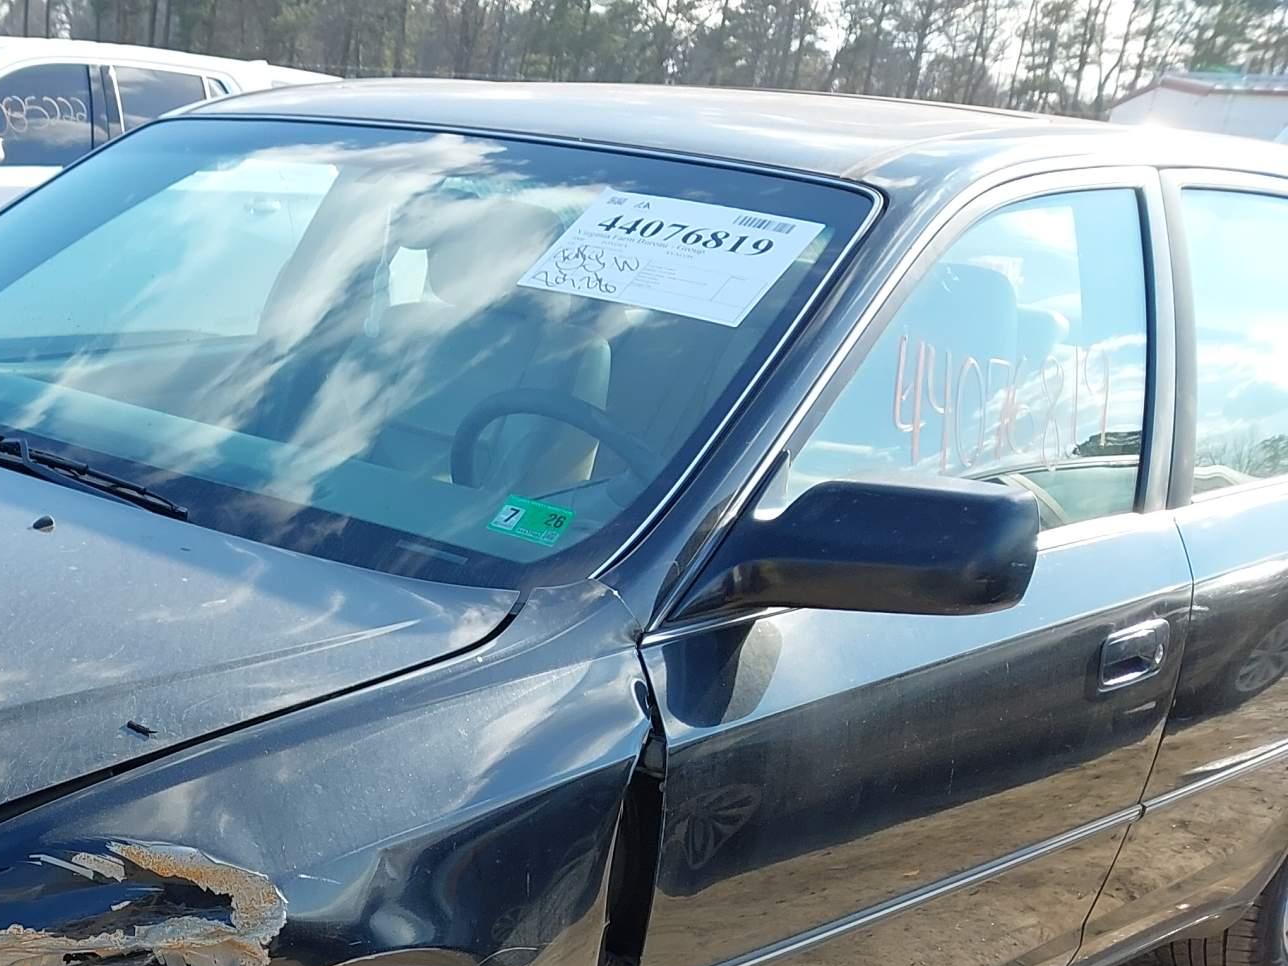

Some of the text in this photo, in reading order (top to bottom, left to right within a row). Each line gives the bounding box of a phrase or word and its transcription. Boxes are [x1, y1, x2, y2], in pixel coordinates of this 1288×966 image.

[598, 214, 774, 257] 44076819
[503, 507, 521, 523] 7
[543, 513, 567, 529] 26
